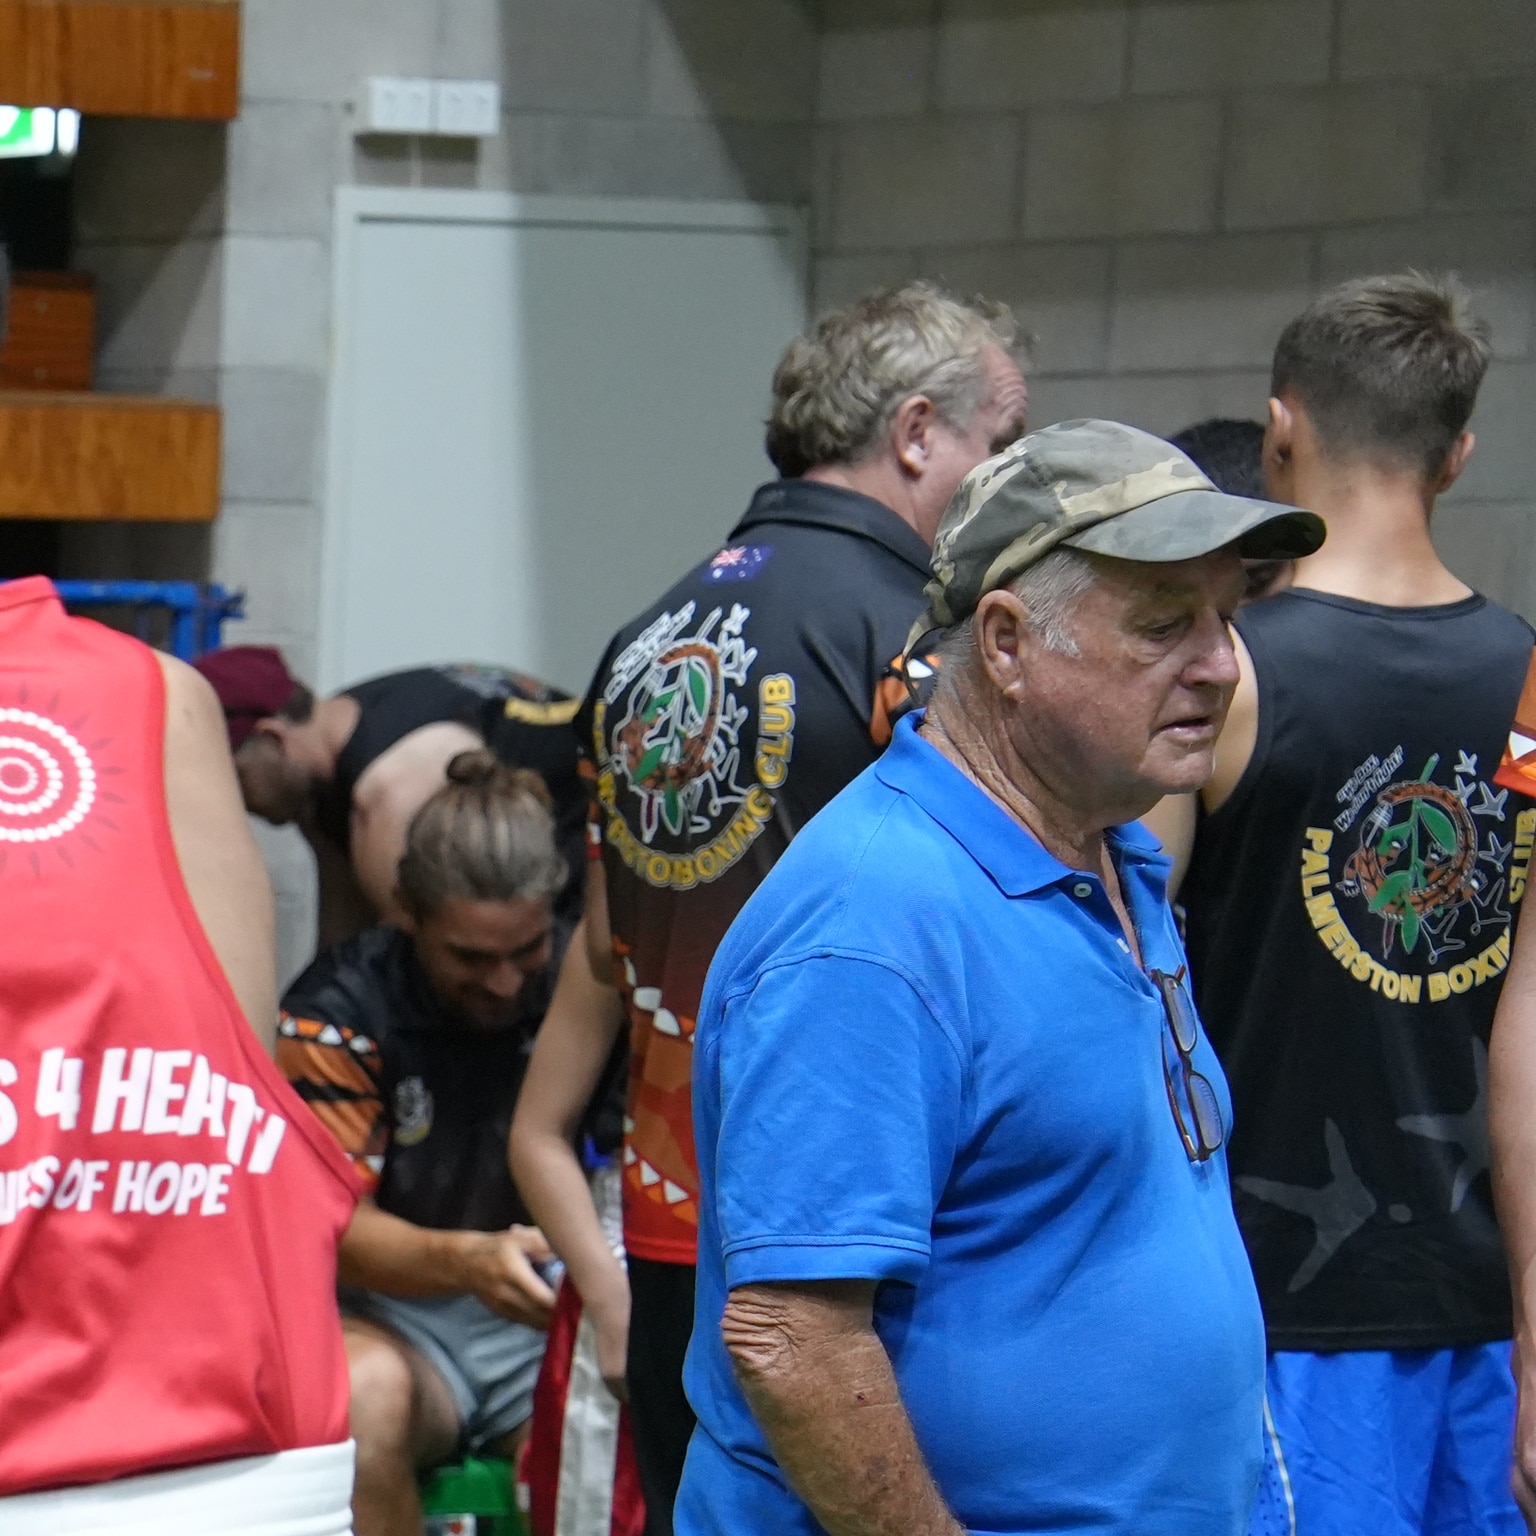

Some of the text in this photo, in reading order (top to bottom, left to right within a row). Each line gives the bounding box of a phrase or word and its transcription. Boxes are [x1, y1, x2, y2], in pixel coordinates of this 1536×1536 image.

[756, 672, 796, 788] CLUB
[1301, 827, 1422, 1003] PALMERSTON
[35, 1047, 84, 1130] 4
[54, 1159, 109, 1212] OF
[112, 1160, 233, 1216] HOPE
